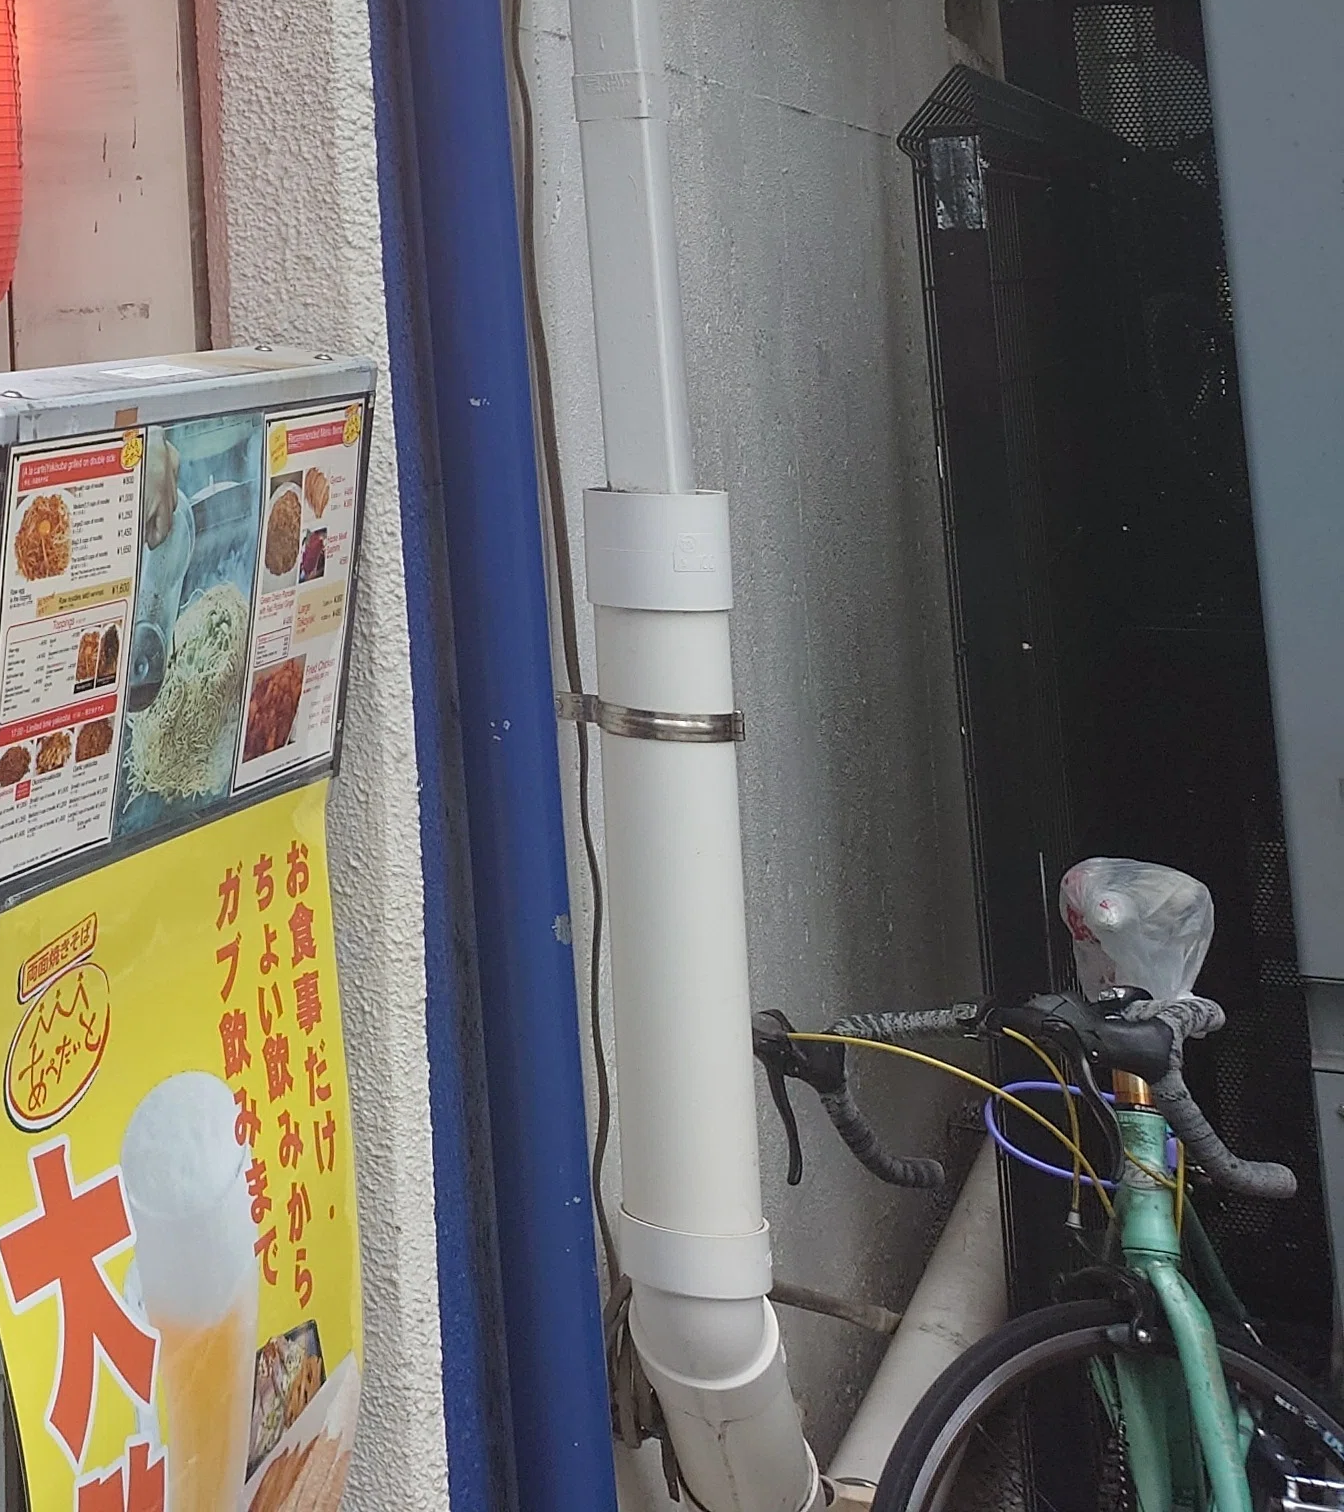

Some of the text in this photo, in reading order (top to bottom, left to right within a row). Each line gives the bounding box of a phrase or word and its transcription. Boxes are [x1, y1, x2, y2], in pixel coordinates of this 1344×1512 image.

[18, 1012, 101, 1112] あぺたいと
[26, 919, 92, 988] 両面焼きそば
[214, 866, 279, 1288] ガブ飲みまで
[252, 852, 315, 1310] ちょい飲みから
